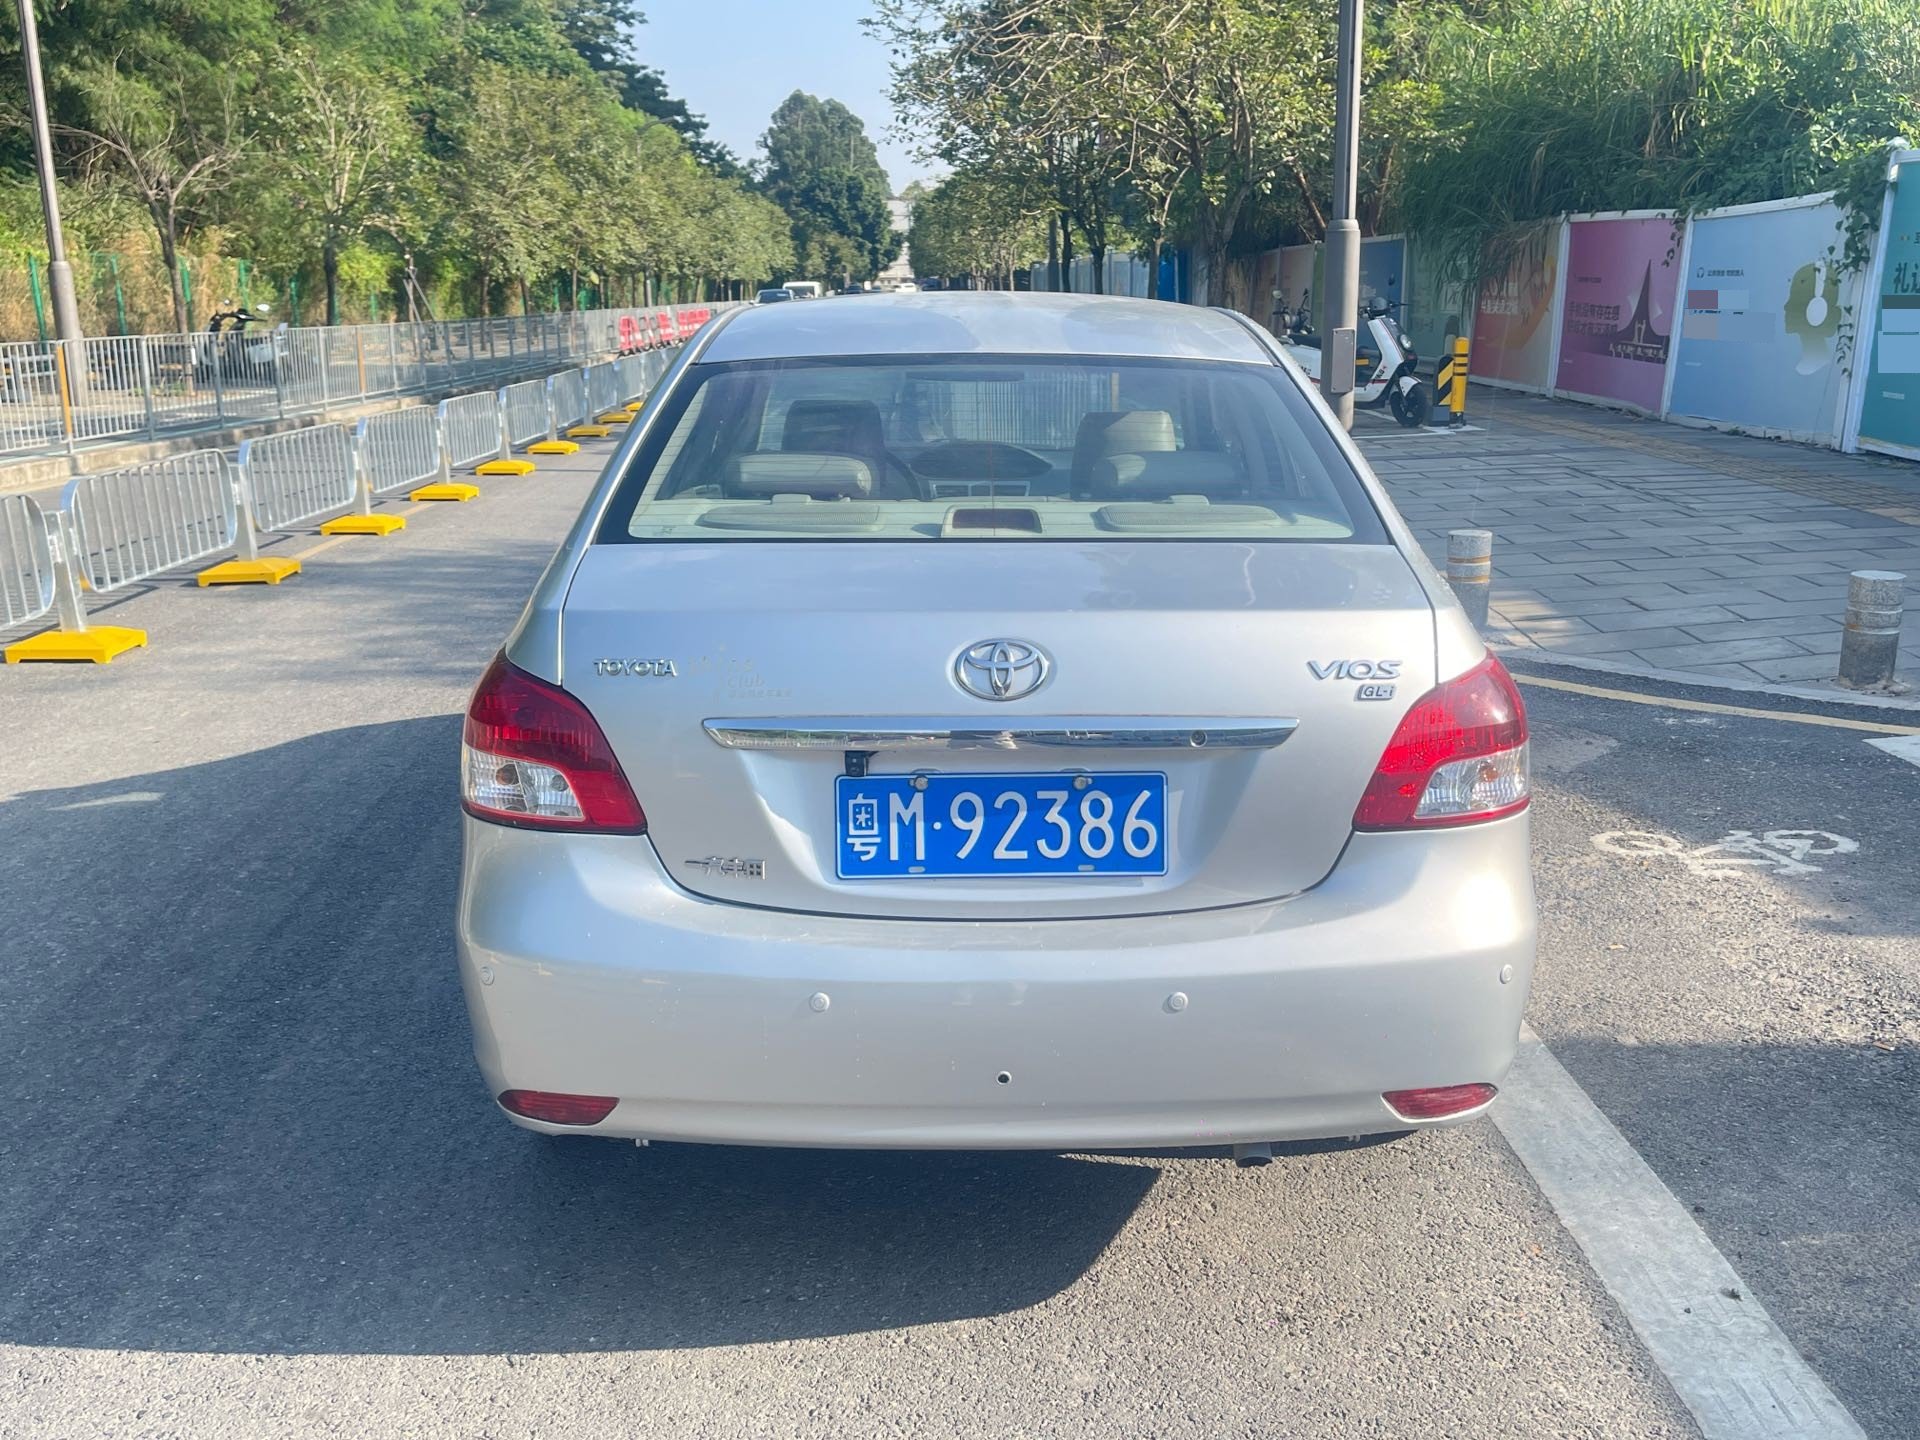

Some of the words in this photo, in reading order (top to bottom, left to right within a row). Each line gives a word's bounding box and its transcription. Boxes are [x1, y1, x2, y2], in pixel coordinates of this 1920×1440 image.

[593, 659, 678, 677] TOYOTA
[1306, 660, 1402, 680] VIOS
[846, 790, 1158, 861] 粤M·92386
